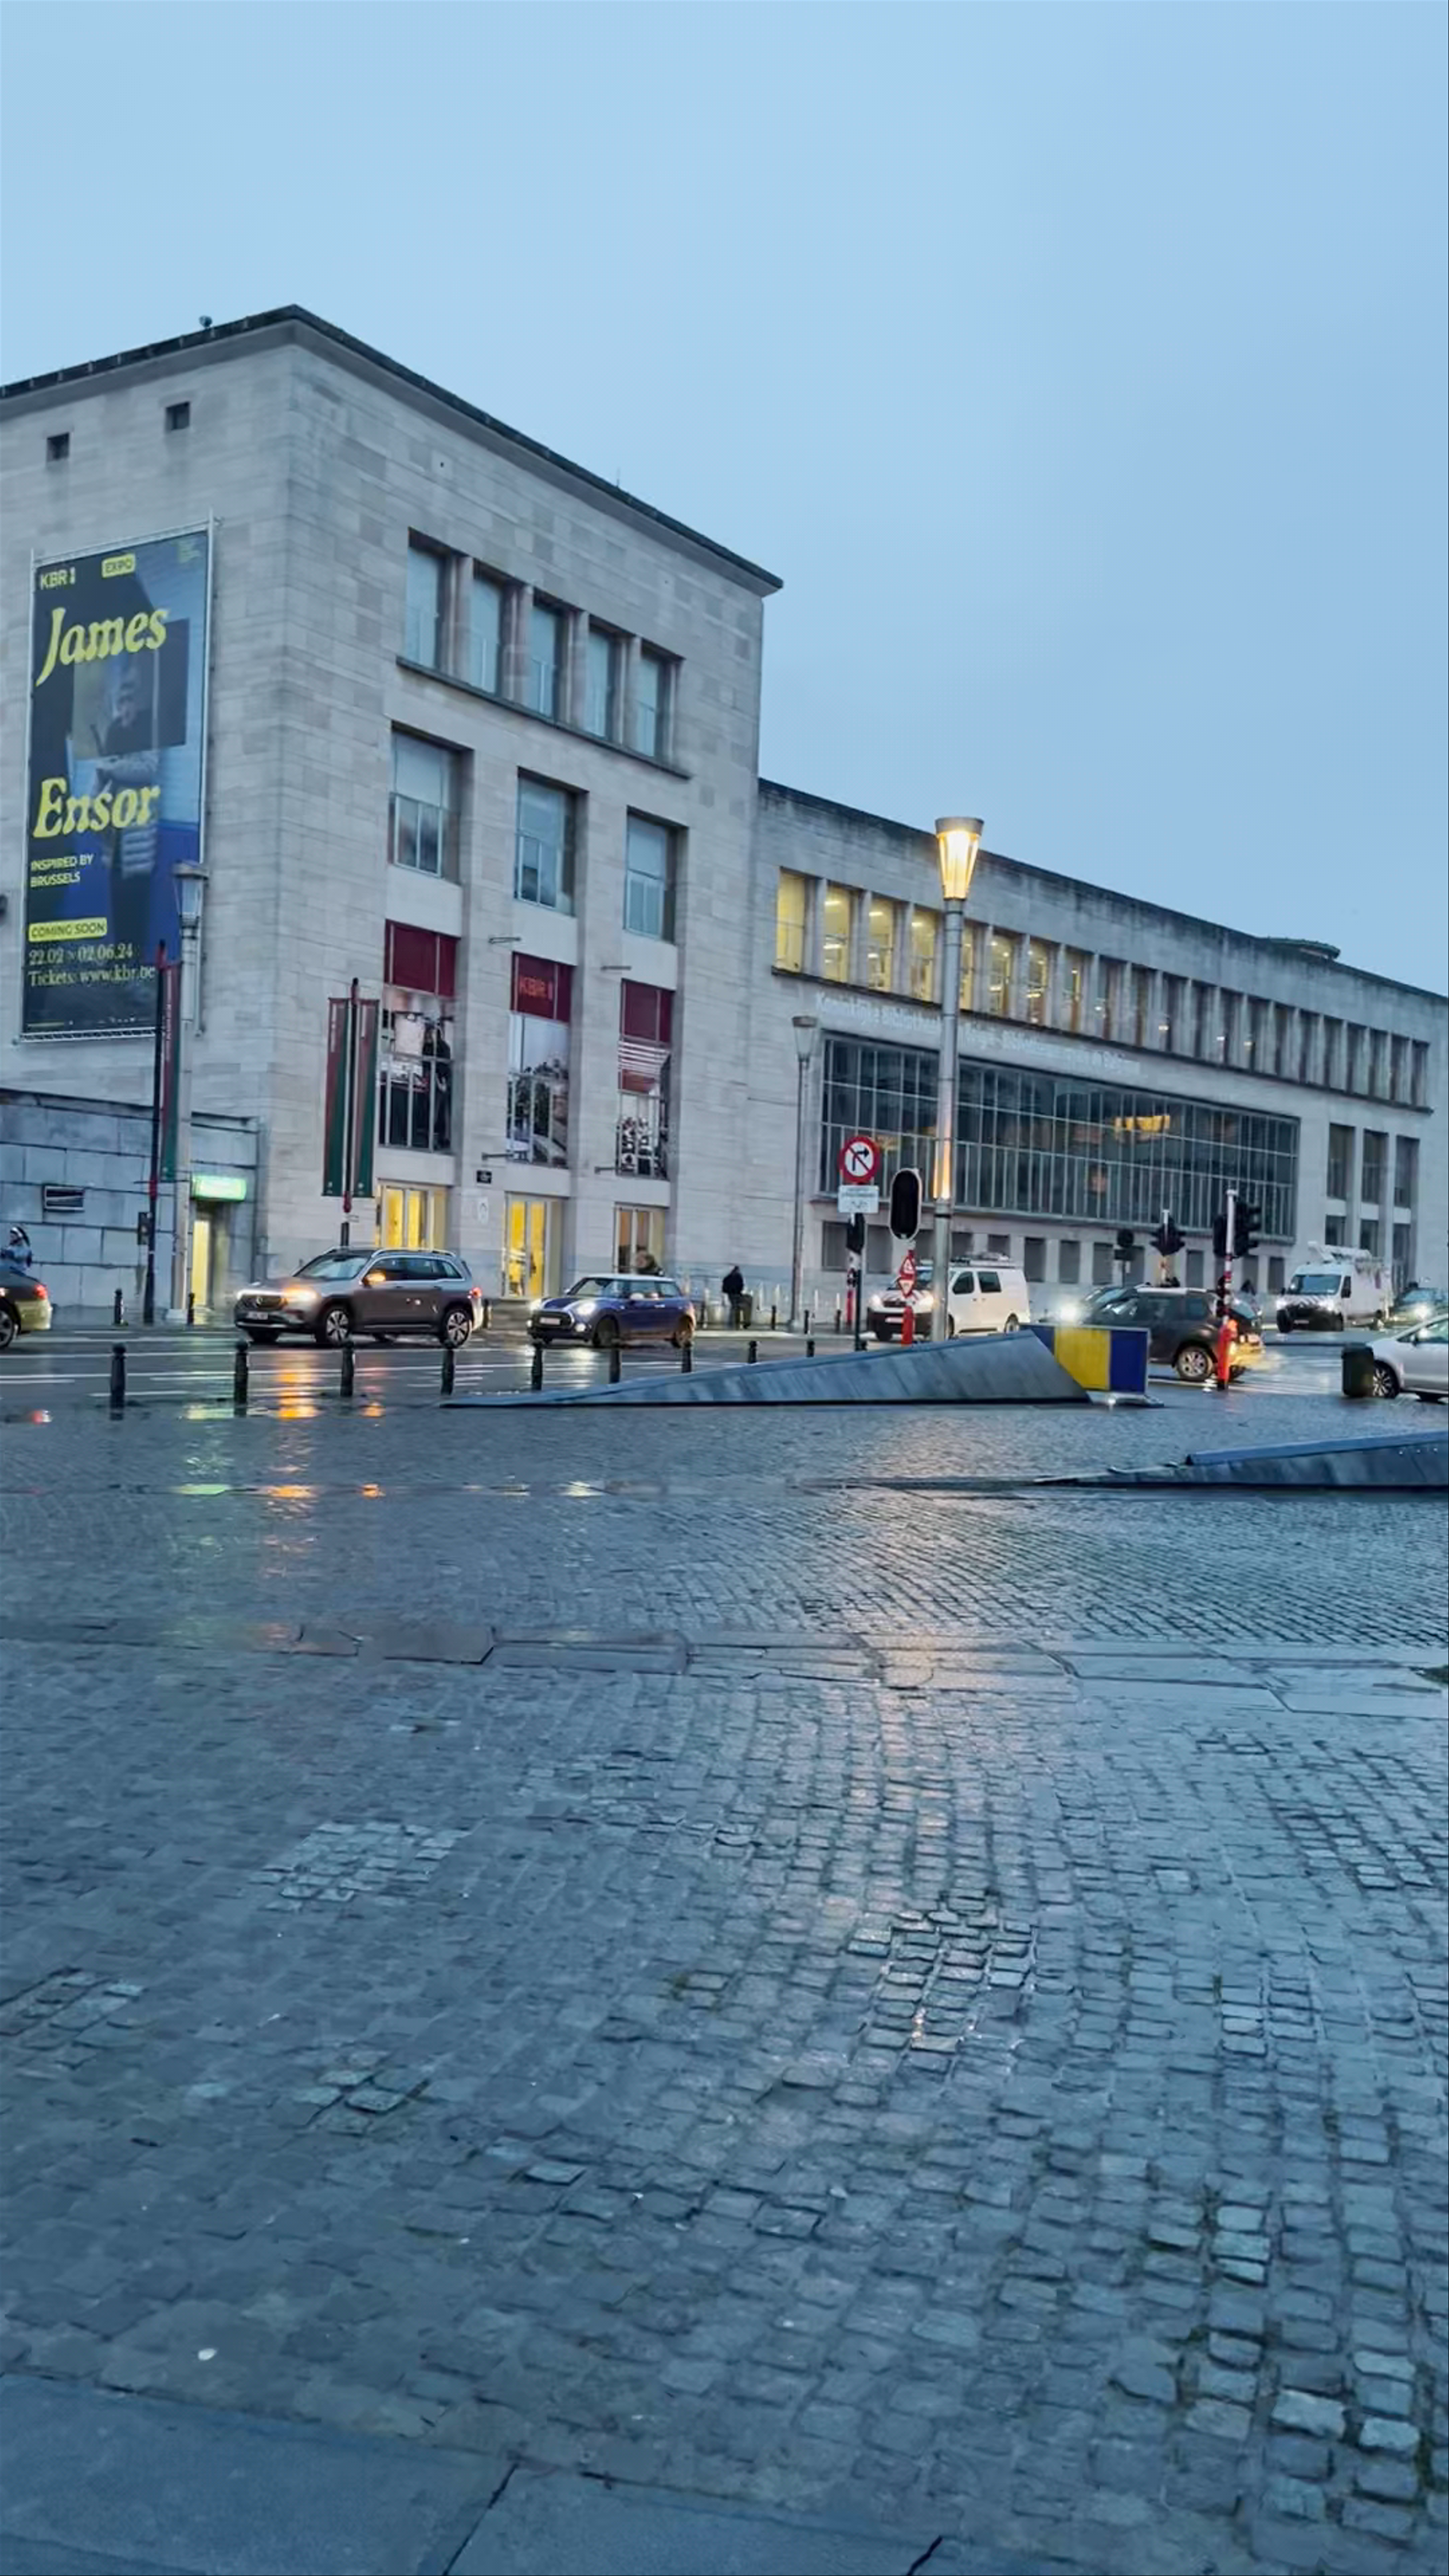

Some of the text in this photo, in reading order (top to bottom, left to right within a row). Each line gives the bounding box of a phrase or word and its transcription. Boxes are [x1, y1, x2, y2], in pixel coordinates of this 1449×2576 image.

[105, 558, 132, 572] EXPO
[35, 607, 171, 687] James
[33, 777, 161, 837] Ensor
[31, 853, 94, 872] INSPIRED BY
[31, 871, 80, 887] BRUSSELS
[31, 923, 105, 938] COMING SOON
